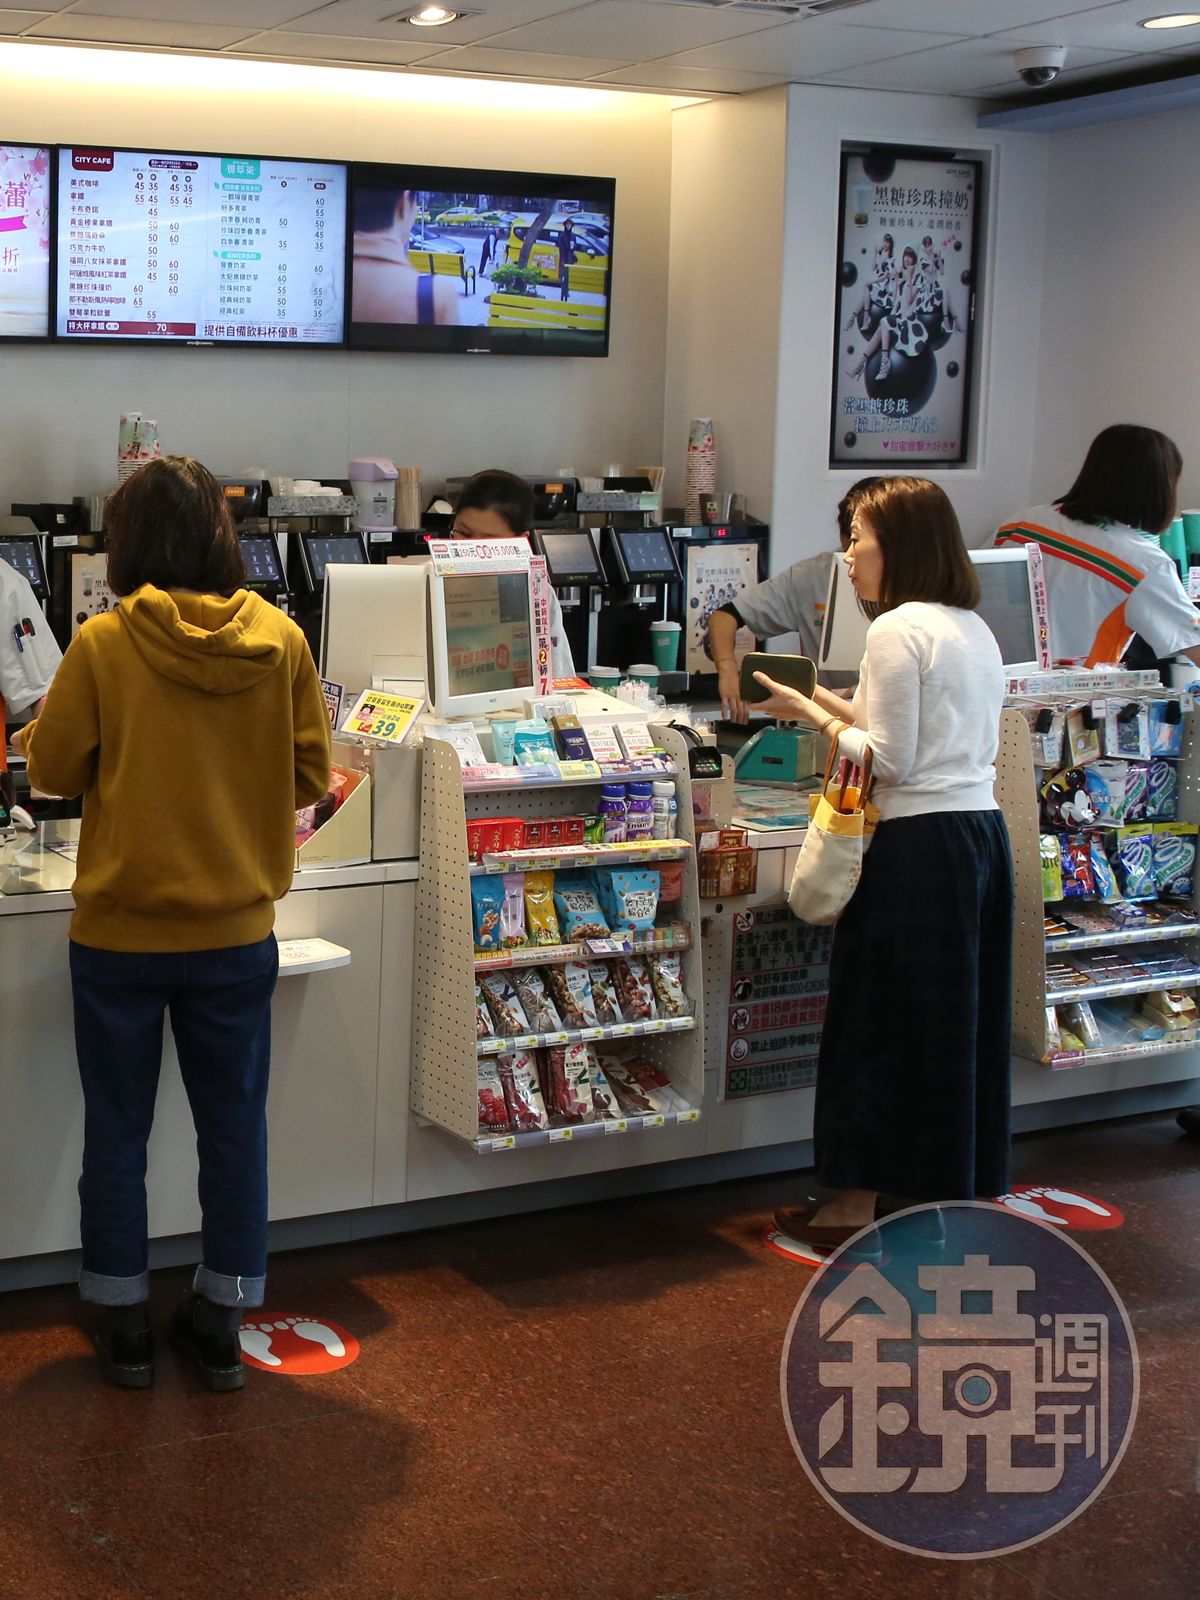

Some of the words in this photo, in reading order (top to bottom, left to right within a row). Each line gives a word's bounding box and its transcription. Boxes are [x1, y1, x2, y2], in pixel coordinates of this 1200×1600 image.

[70, 179, 98, 187] 美式咖啡
[135, 182, 144, 190] 45
[170, 184, 179, 192] 45
[874, 186, 968, 210] 黑糖珍珠撞奶
[169, 235, 179, 243] 60
[277, 309, 285, 317] 35
[314, 310, 322, 318] 35
[204, 325, 298, 338] 提供自備飲料杯優惠
